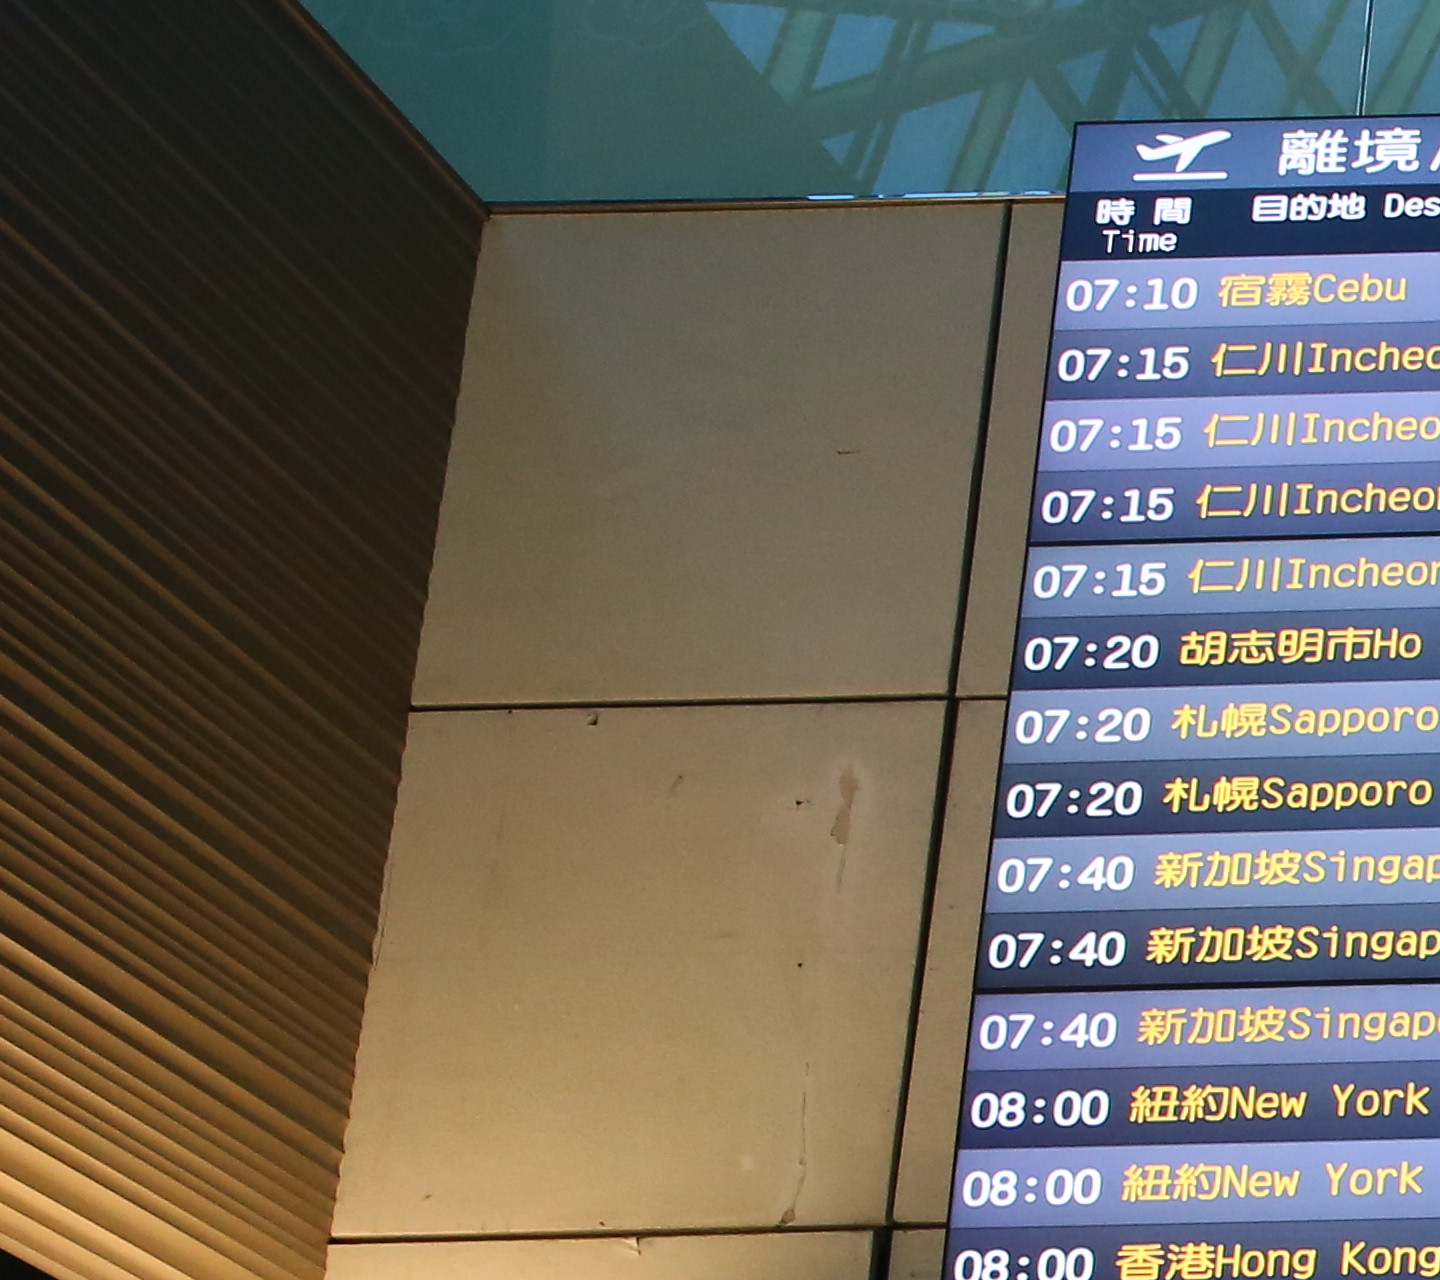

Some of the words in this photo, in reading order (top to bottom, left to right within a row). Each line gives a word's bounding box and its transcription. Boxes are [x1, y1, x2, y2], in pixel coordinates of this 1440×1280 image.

[1252, 192, 1366, 222] 目的地
[1102, 229, 1178, 254] Time
[1066, 277, 1198, 312] 07:10
[1024, 634, 1159, 671] 07:20
